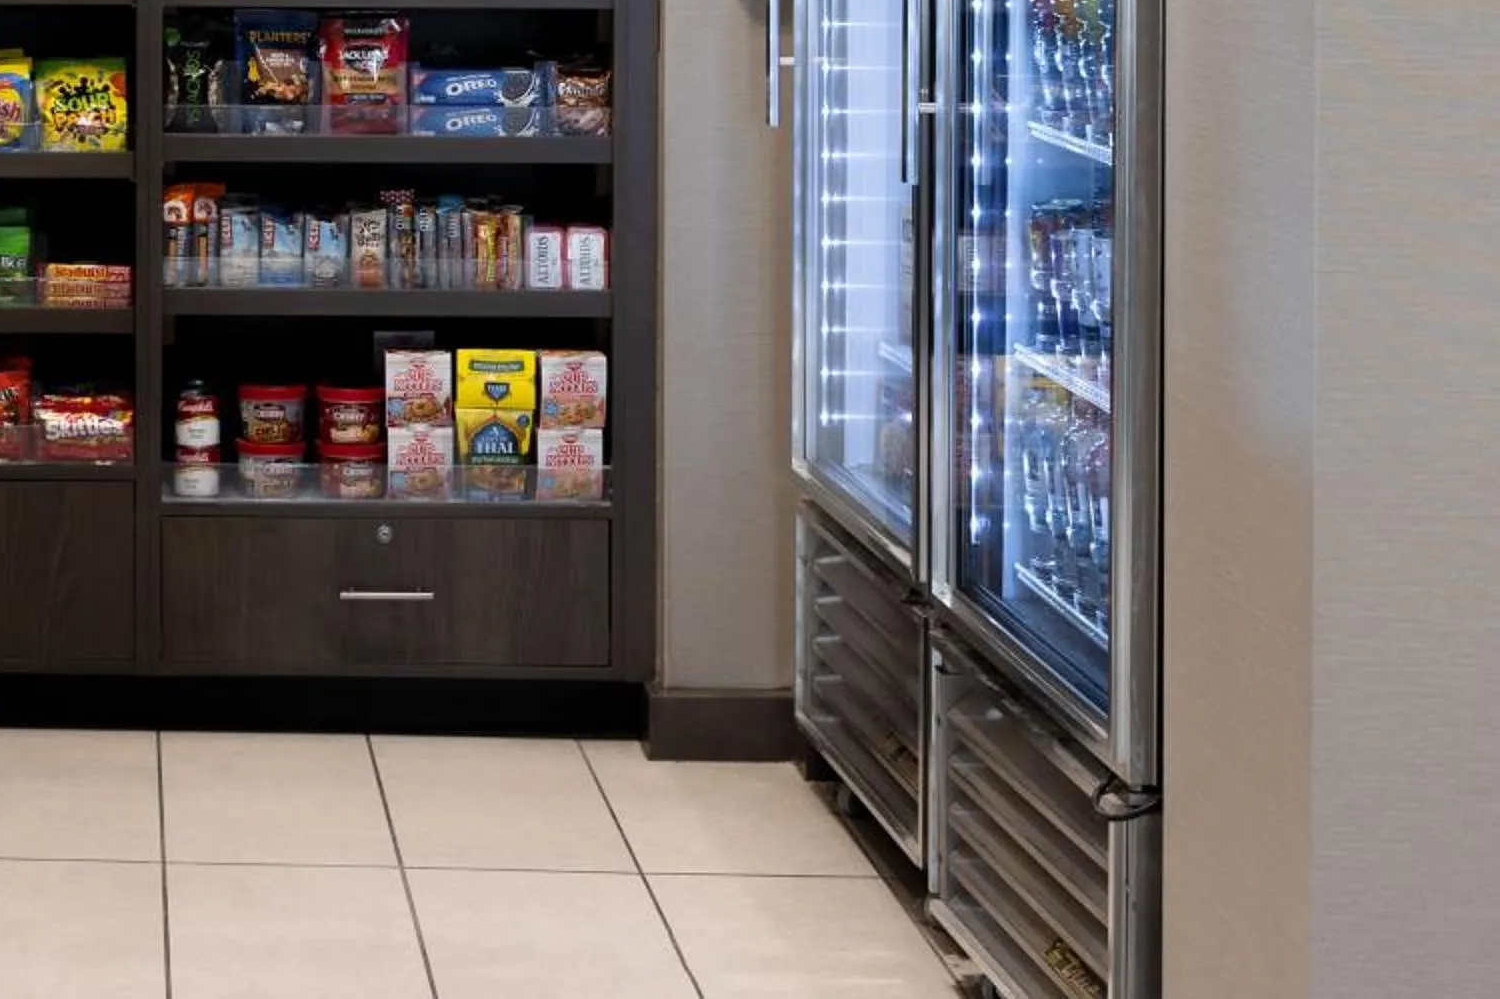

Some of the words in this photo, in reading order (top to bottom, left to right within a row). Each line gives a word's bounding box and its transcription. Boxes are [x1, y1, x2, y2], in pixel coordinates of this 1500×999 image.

[446, 79, 497, 96] OREO
[54, 92, 110, 113] SOUR
[446, 113, 497, 131] OREO
[537, 236, 549, 284] ALTOIDS
[475, 441, 514, 454] THAI
